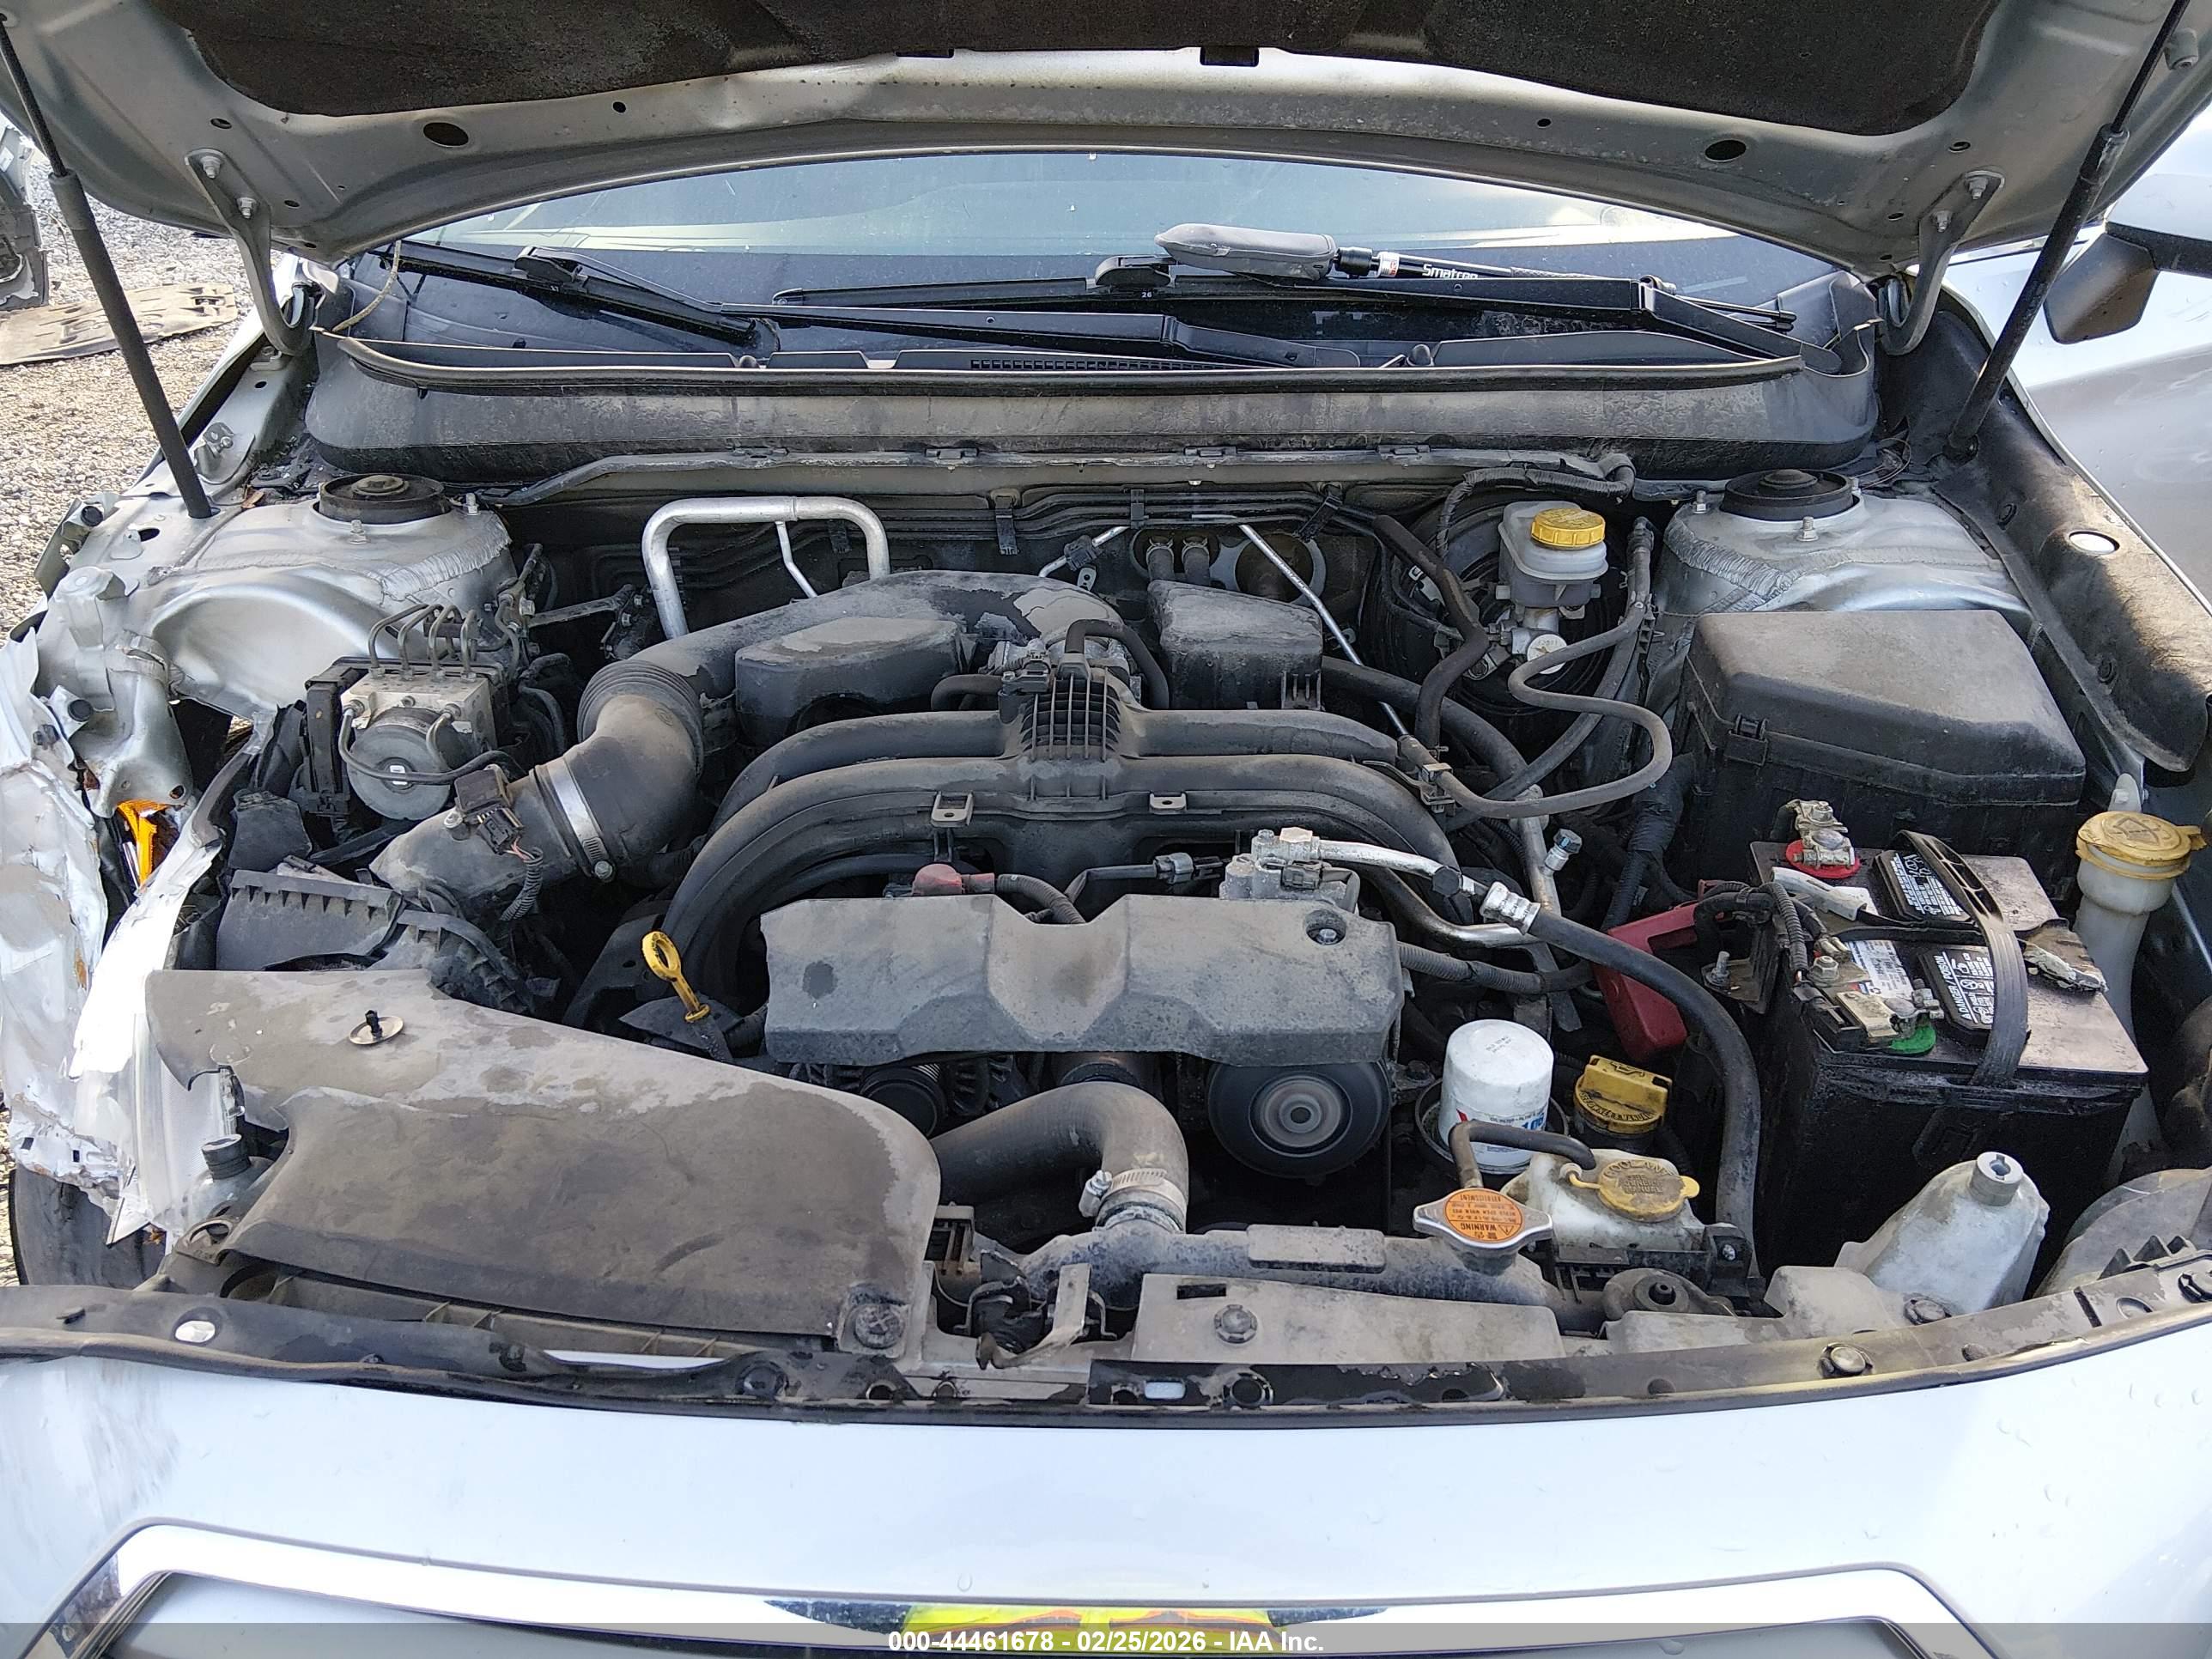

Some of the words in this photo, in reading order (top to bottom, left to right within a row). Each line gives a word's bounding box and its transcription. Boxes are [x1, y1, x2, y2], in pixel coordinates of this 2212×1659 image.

[1934, 955, 1954, 981] POISON
[1948, 985, 1970, 1013] DANGER
[1621, 1111, 1654, 1121] MANUAL
[1461, 1222, 1497, 1231] WARNING
